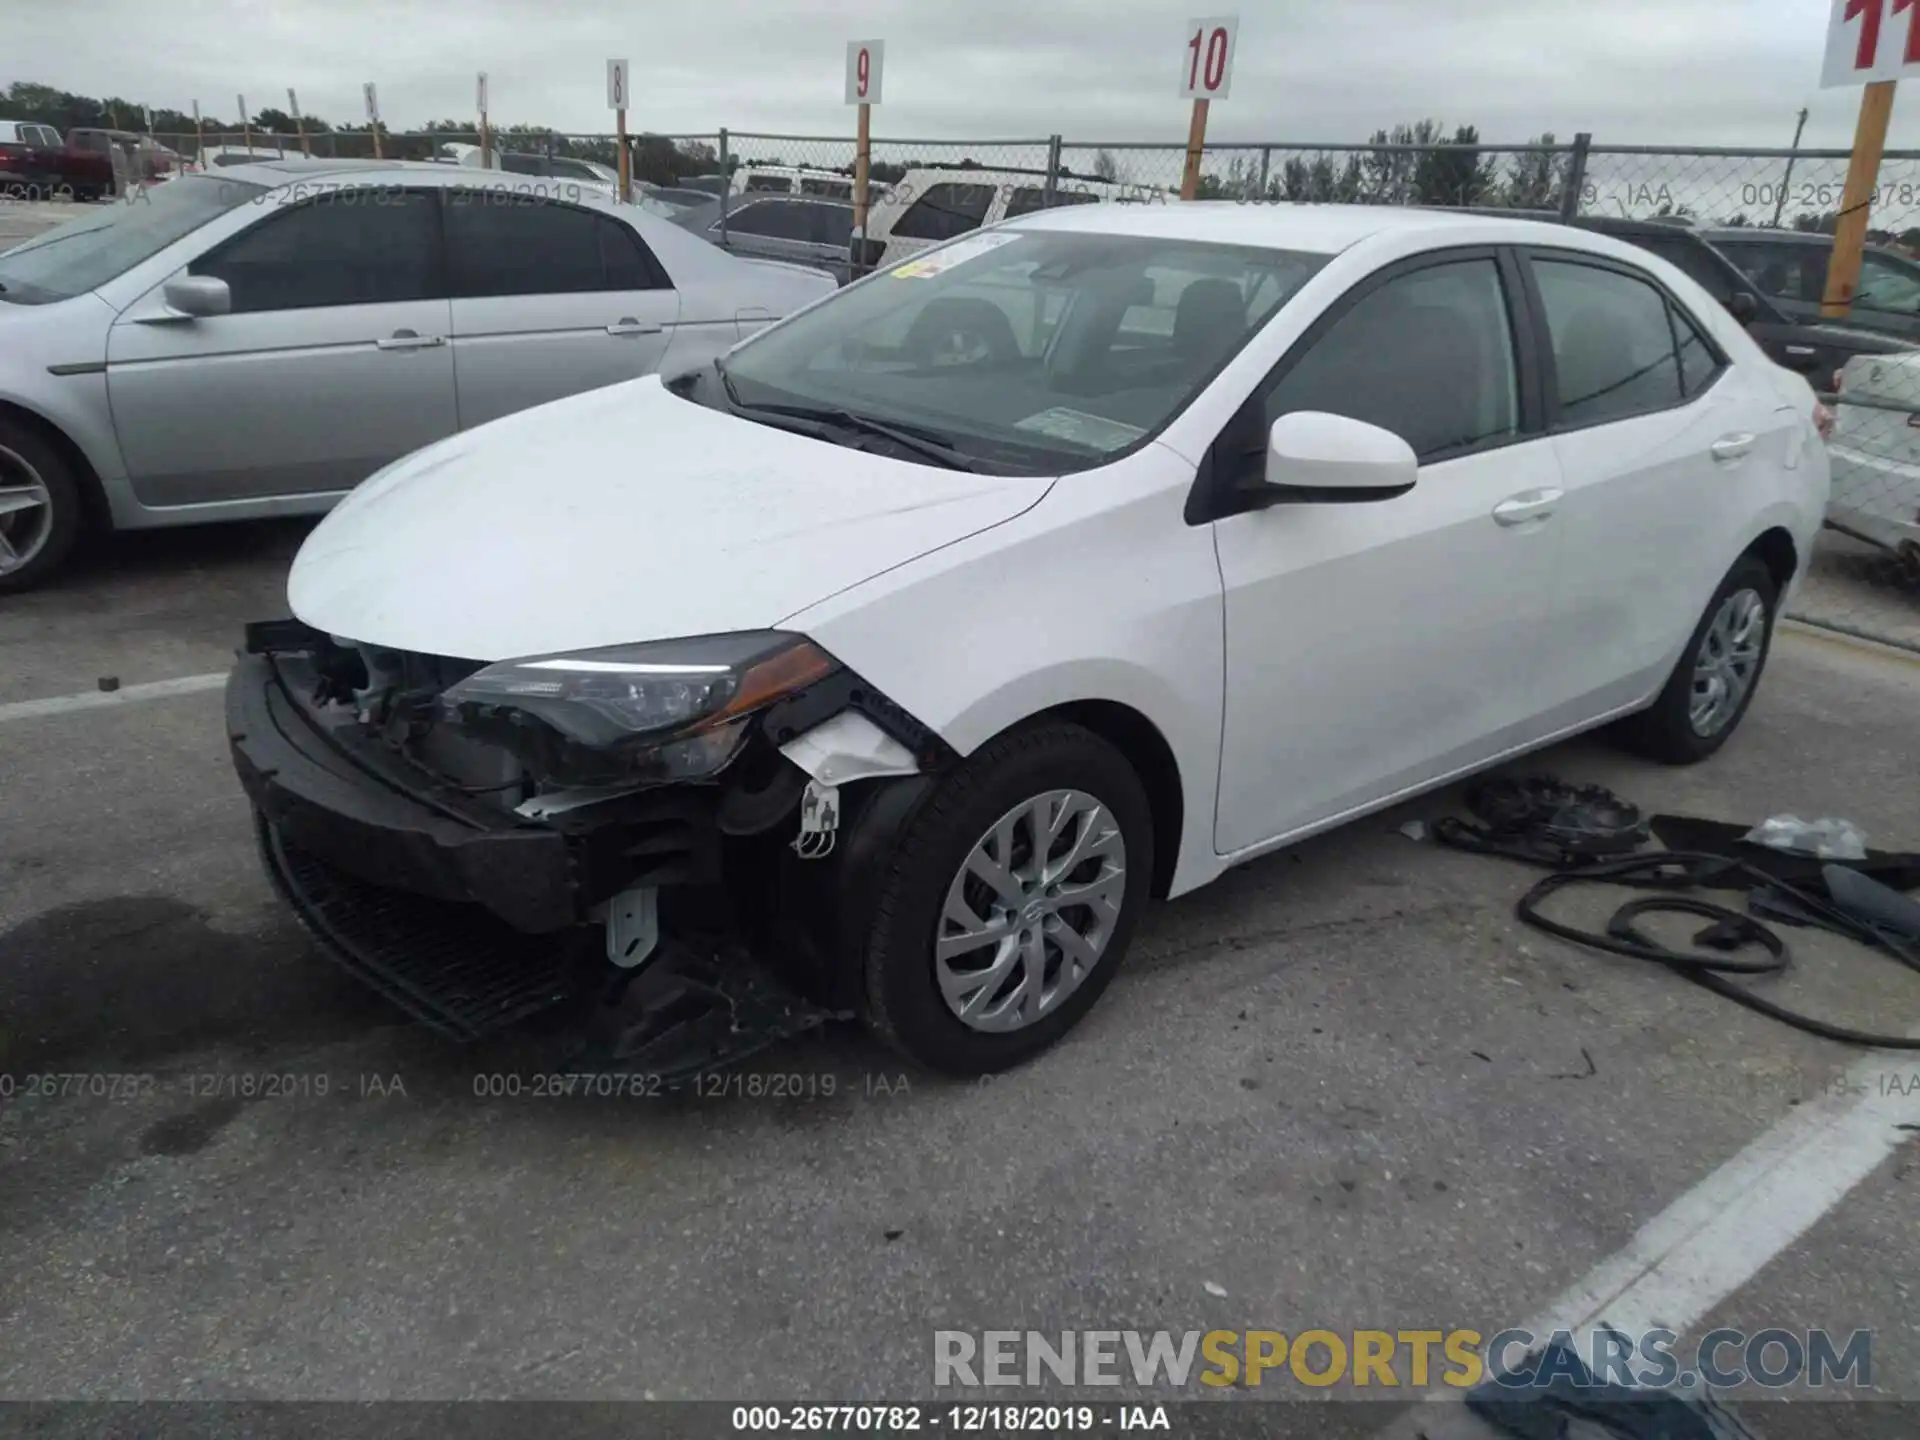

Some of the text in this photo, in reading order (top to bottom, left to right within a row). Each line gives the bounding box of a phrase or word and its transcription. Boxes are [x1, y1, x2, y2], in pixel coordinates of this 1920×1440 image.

[1188, 27, 1227, 91] 10
[1843, 0, 1920, 69] 11
[614, 65, 622, 104] 8
[857, 47, 869, 97] 9
